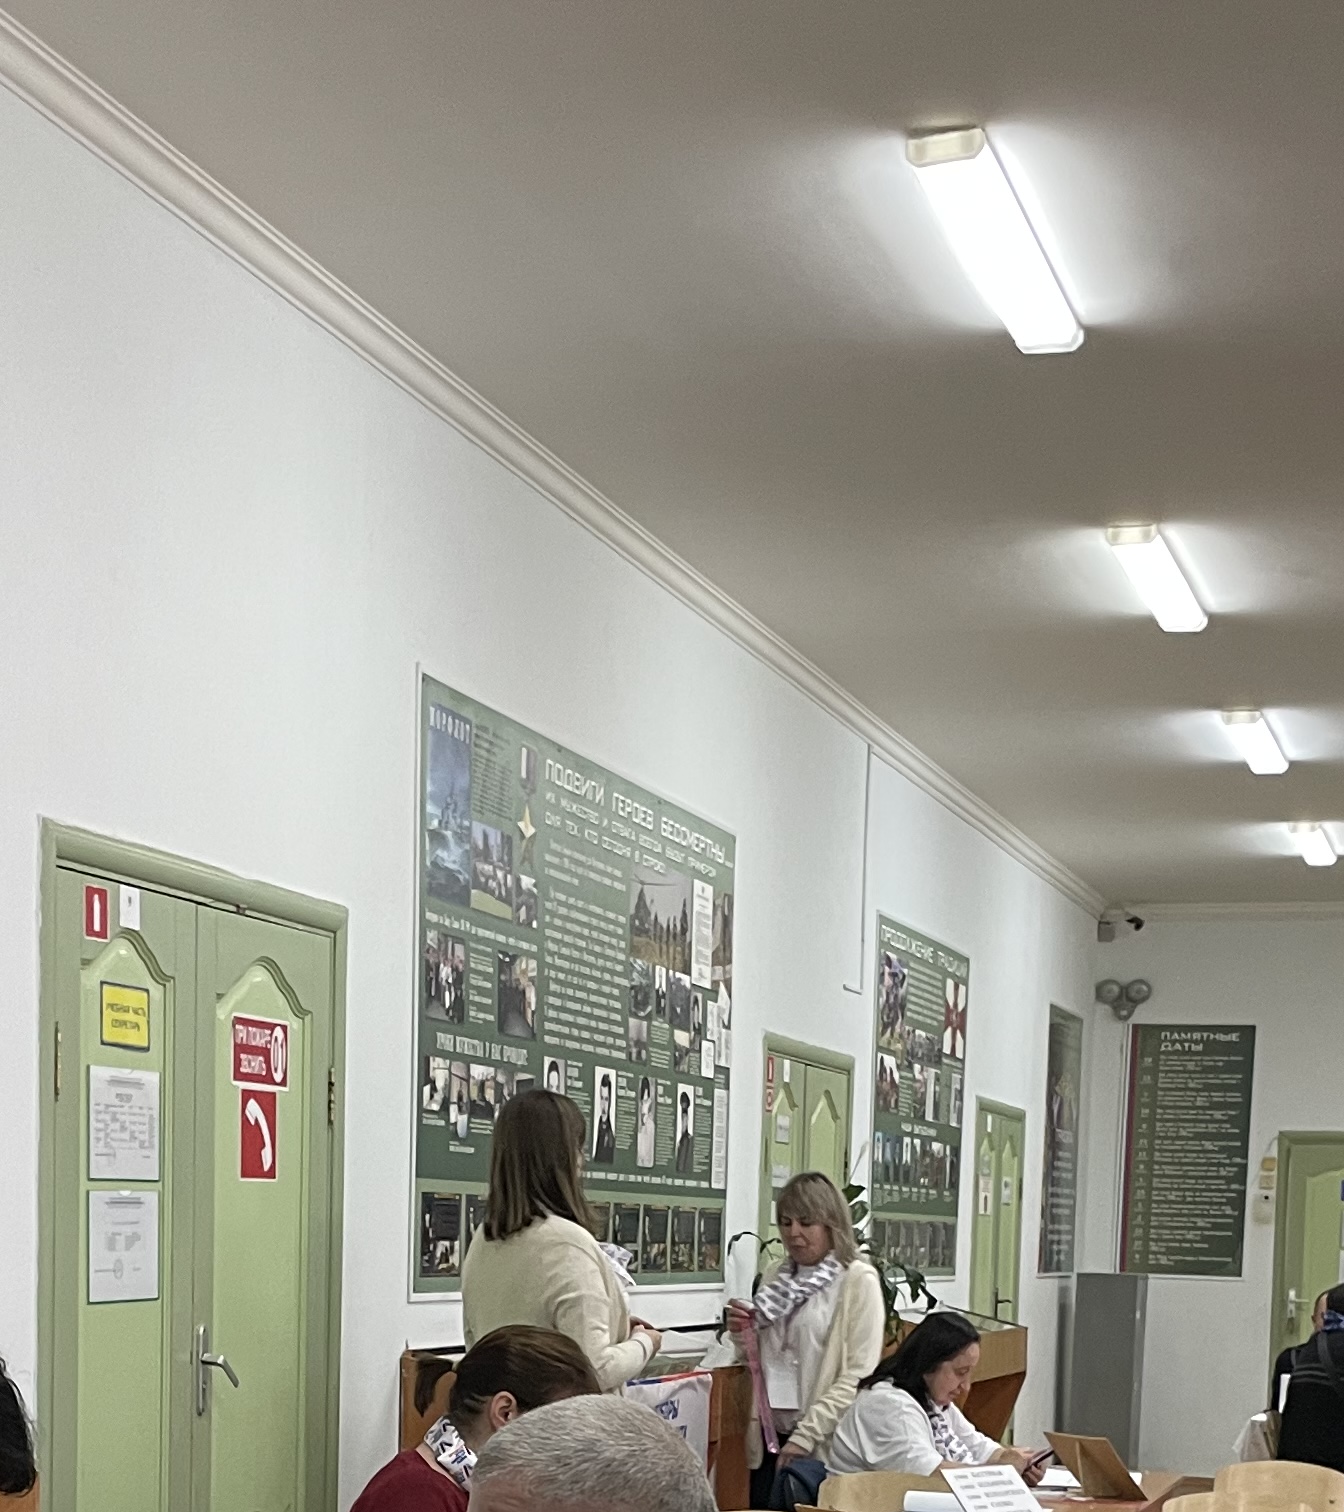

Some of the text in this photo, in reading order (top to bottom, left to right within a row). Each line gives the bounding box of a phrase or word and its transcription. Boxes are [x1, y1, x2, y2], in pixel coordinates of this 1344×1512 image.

[545, 758, 605, 807] ПОДВИГИ
[611, 791, 655, 831] ГЕРОЕВ
[1160, 1031, 1241, 1042] ПАМЯТНЫЕ
[1159, 1042, 1204, 1052] ДАТЫ
